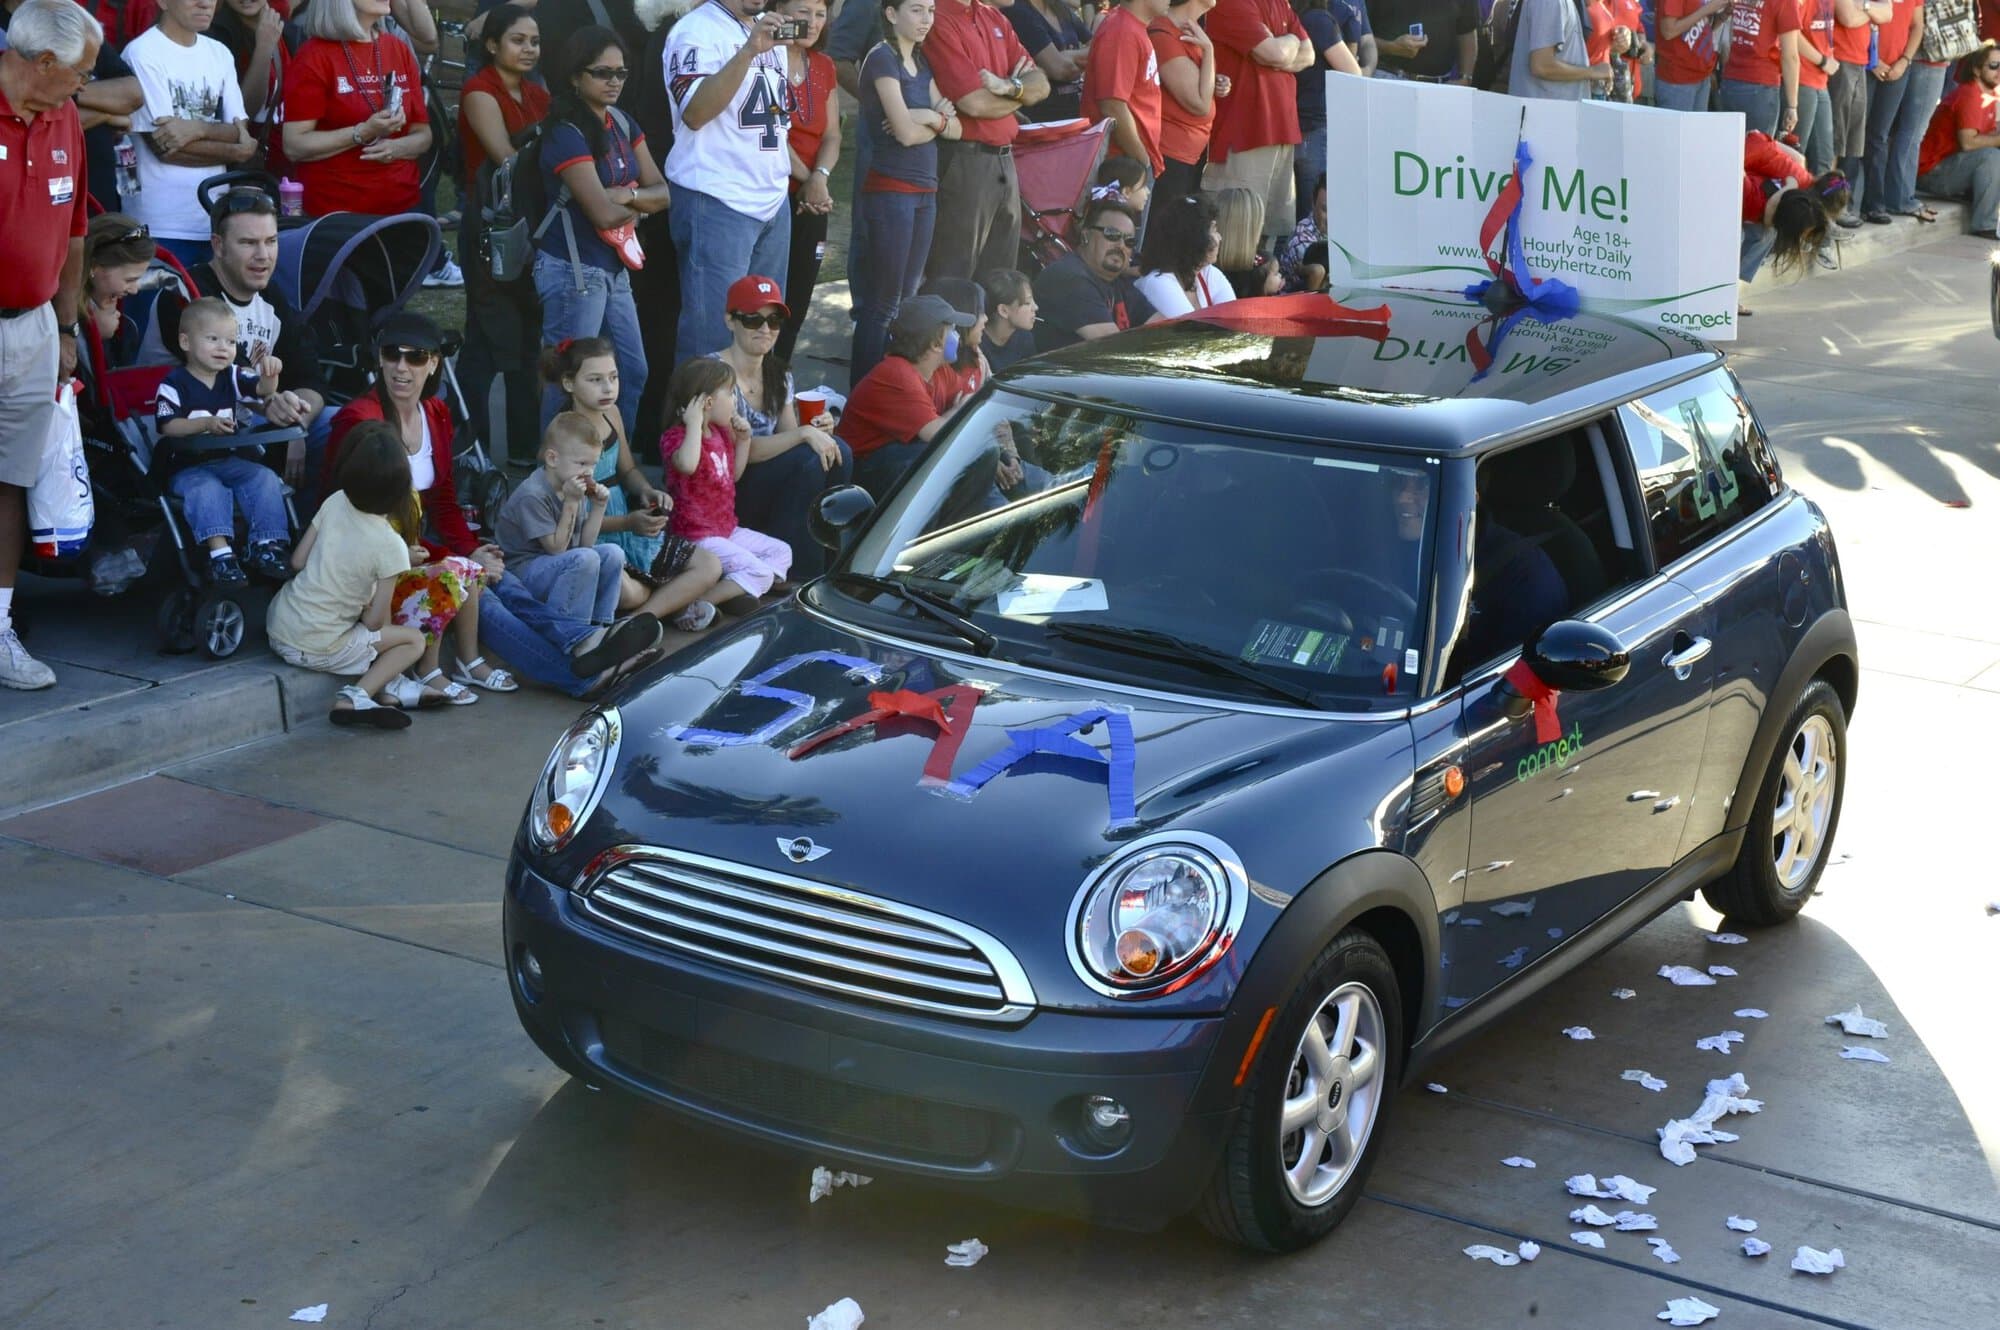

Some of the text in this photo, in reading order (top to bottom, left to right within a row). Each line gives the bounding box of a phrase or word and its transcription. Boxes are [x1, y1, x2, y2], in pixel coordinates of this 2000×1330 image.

[669, 48, 697, 73] 44
[1542, 166, 1628, 223] Me!
[1573, 225, 1631, 248] Age 18+
[1523, 237, 1631, 268] Hourly or Daily
[1661, 310, 1732, 328] connect
[1518, 721, 1584, 782] connect
